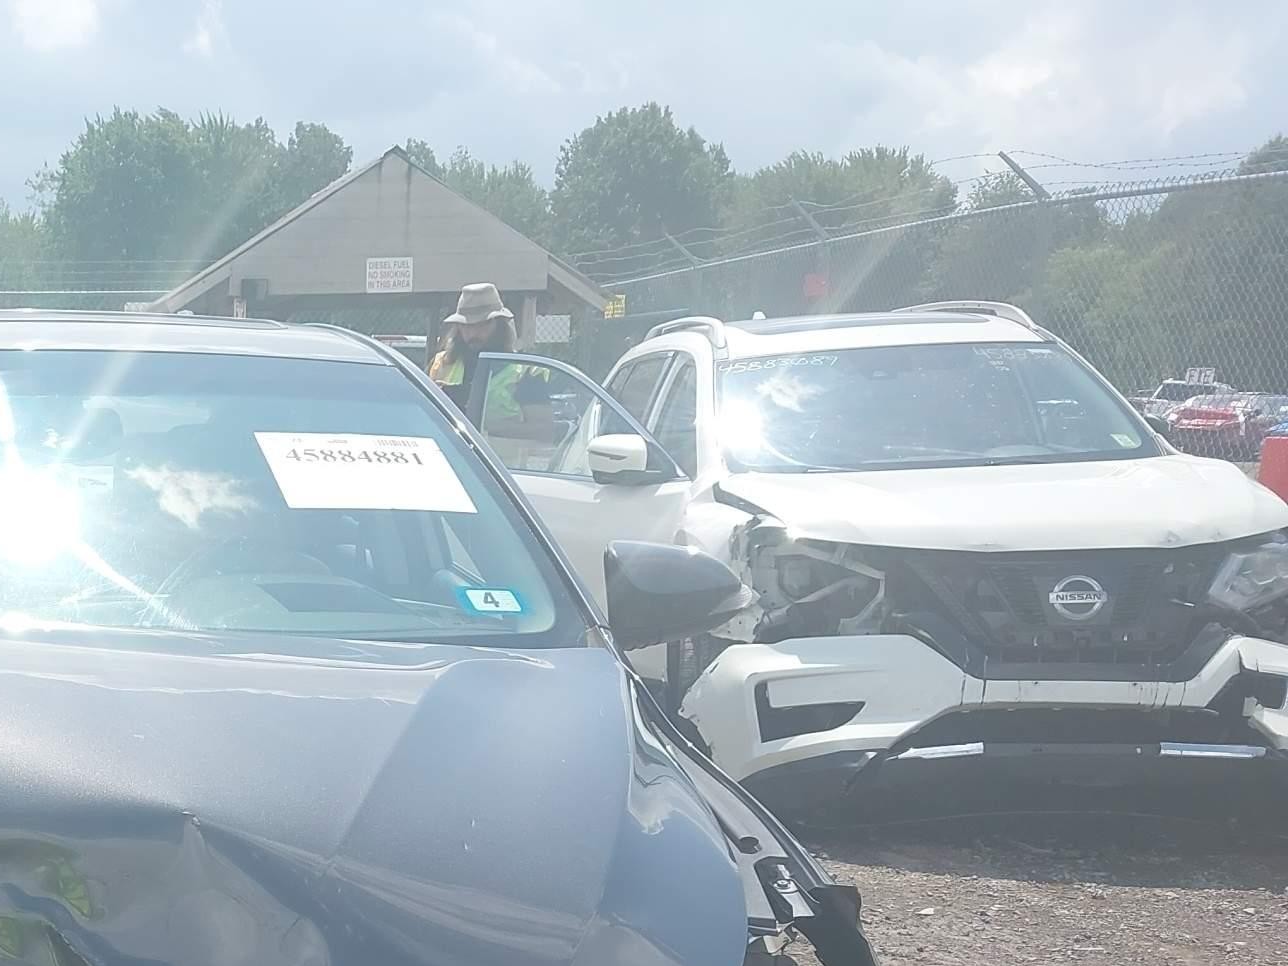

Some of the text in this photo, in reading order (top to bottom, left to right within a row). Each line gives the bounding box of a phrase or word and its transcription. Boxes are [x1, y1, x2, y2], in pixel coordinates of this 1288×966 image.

[368, 260, 410, 270] DIESEL FUEL
[368, 270, 410, 279] NO SMOKING
[376, 280, 391, 288] THIS
[392, 279, 410, 288] AREA
[286, 448, 425, 466] 45884881
[483, 591, 500, 608] 4
[1056, 593, 1100, 601] NISSAN
